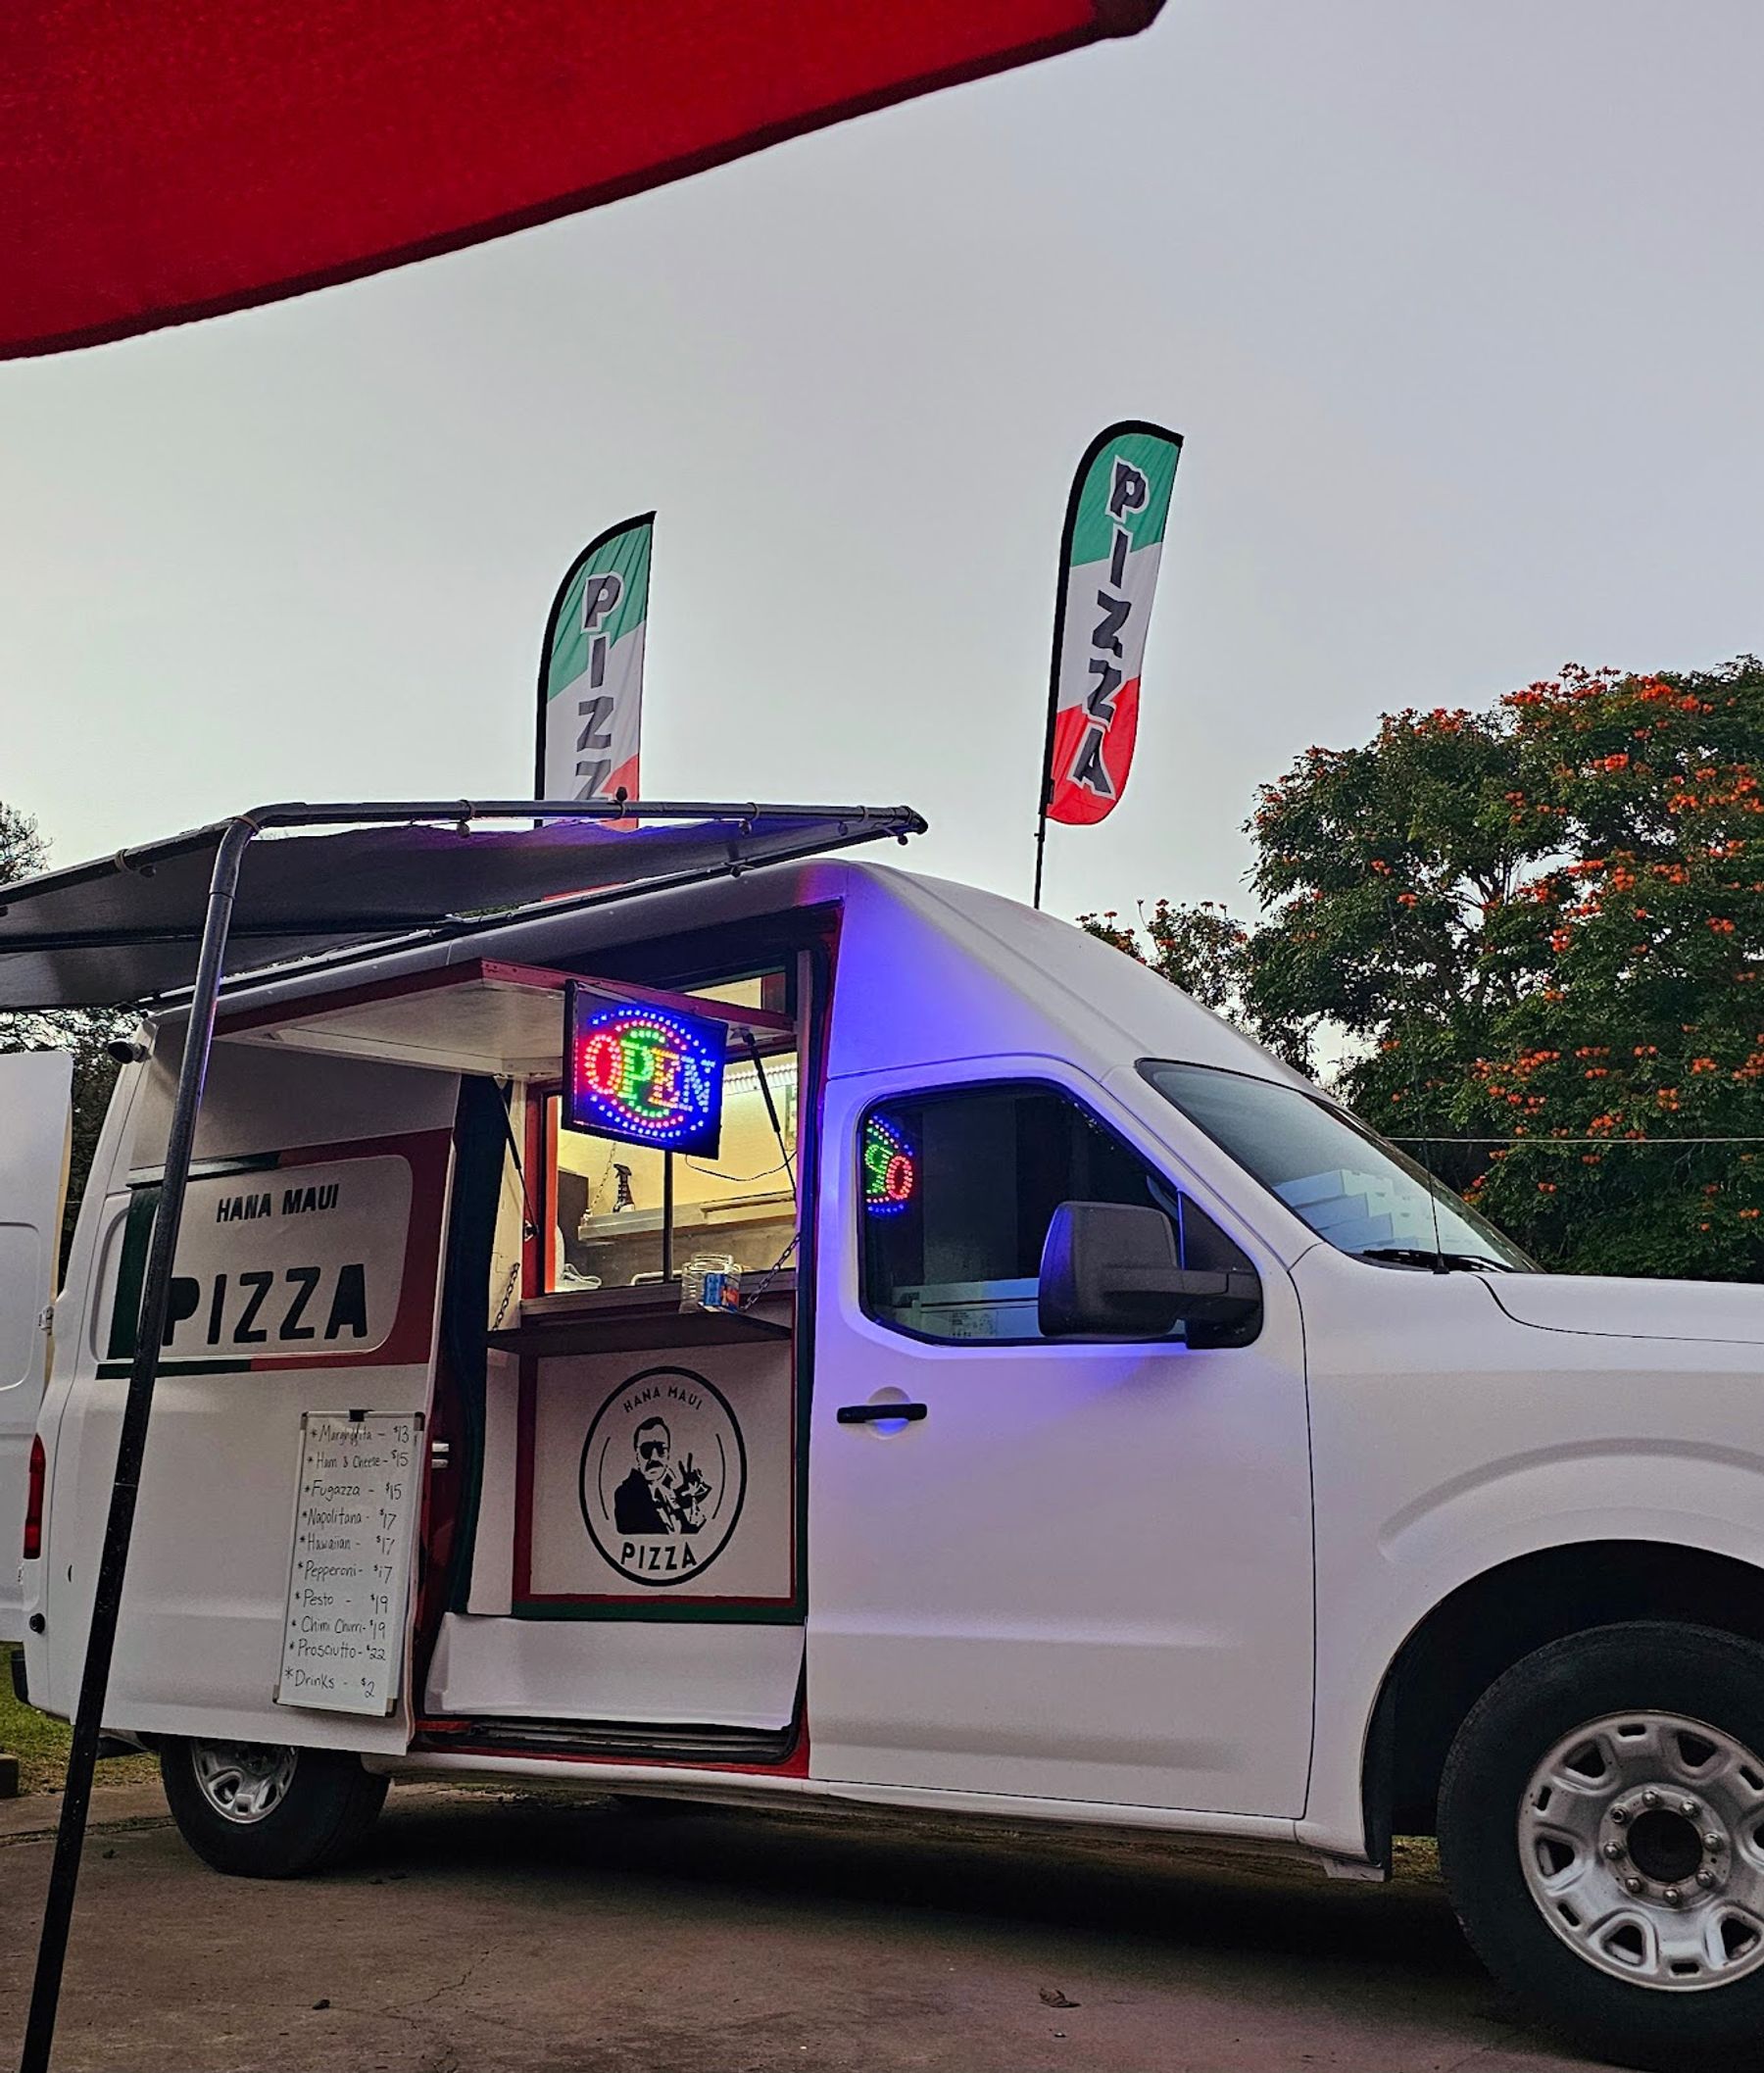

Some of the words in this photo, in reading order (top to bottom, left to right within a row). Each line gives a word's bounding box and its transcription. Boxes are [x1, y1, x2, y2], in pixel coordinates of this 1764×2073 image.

[1068, 456, 1149, 798] PIZZA
[575, 570, 624, 801] PIZZ
[584, 1034, 715, 1113] OPEN
[217, 1193, 271, 1223] HANA
[282, 1183, 339, 1216] MAUI
[162, 1263, 368, 1347] PIZZA
[623, 1387, 661, 1412] HANA
[667, 1386, 703, 1410] MAUI
[393, 1425, 410, 1443] $13
[317, 1452, 337, 1469] Ham
[391, 1450, 409, 1467] $15
[312, 1480, 361, 1502] Fugazza
[386, 1482, 403, 1500] $15
[308, 1507, 362, 1529] Napolitana
[379, 1508, 397, 1530] $17
[376, 1535, 395, 1555] $17
[621, 1542, 697, 1570] PIZZA
[305, 1560, 357, 1582] Pepperoni
[374, 1564, 392, 1584] $17
[303, 1589, 334, 1607] Pesto
[370, 1594, 388, 1614] $19
[301, 1615, 329, 1633] Chimi
[369, 1619, 386, 1640] $19
[367, 1645, 386, 1660] $22
[295, 1669, 335, 1689] Drinks
[361, 1677, 374, 1698] $2
